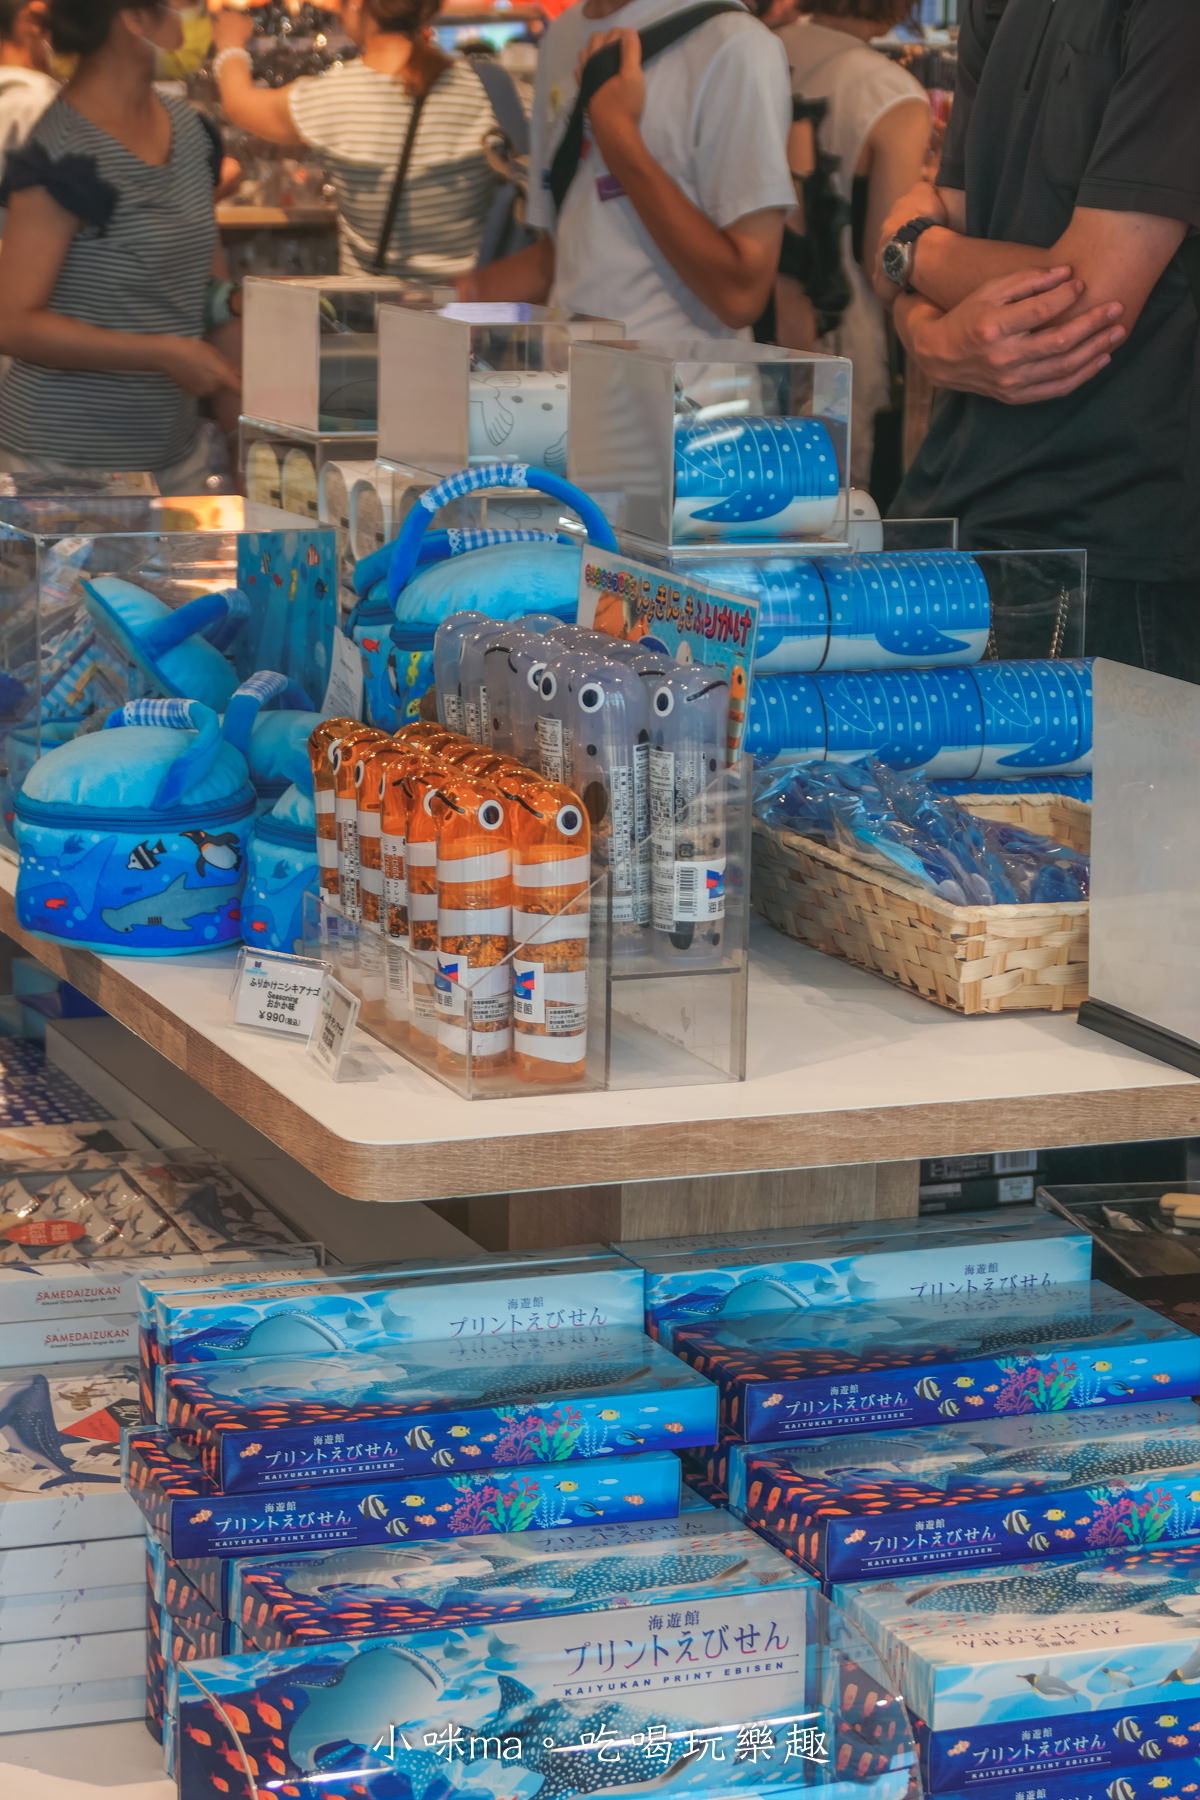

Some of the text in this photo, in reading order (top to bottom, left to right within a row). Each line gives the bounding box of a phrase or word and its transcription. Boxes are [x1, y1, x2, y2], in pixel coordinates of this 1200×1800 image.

[250, 977, 321, 997] ふりかけニシキアナゴ
[267, 991, 299, 1004] Seasoning
[36, 1286, 121, 1301] SAMEDAIZUKAN
[508, 1296, 544, 1310] 海遊館
[450, 1307, 608, 1338] プリントえびせん
[46, 1328, 130, 1344] SAMEDAIZUKAN
[785, 1392, 908, 1418] プリントえびせん
[313, 1433, 345, 1446] 海遊館
[265, 1441, 398, 1469] プリントえびせん
[264, 1470, 317, 1481] KAIYUKAN
[323, 1467, 353, 1475] PRINT
[264, 1501, 297, 1514] 海遊館
[215, 1510, 351, 1536] プリントえびせん
[215, 1537, 268, 1547] KAIYUKAN
[274, 1534, 305, 1542] PRINT
[868, 1526, 997, 1555] プリントえびせん
[923, 1552, 952, 1561] PRINT
[648, 1610, 700, 1631] 海遊館
[564, 1621, 789, 1677] プリントえびせん
[564, 1661, 784, 1696] KAIYUKAN PRINT EBISEN
[973, 1734, 1106, 1766] プリントえびせん
[1030, 1762, 1060, 1771] PRINT
